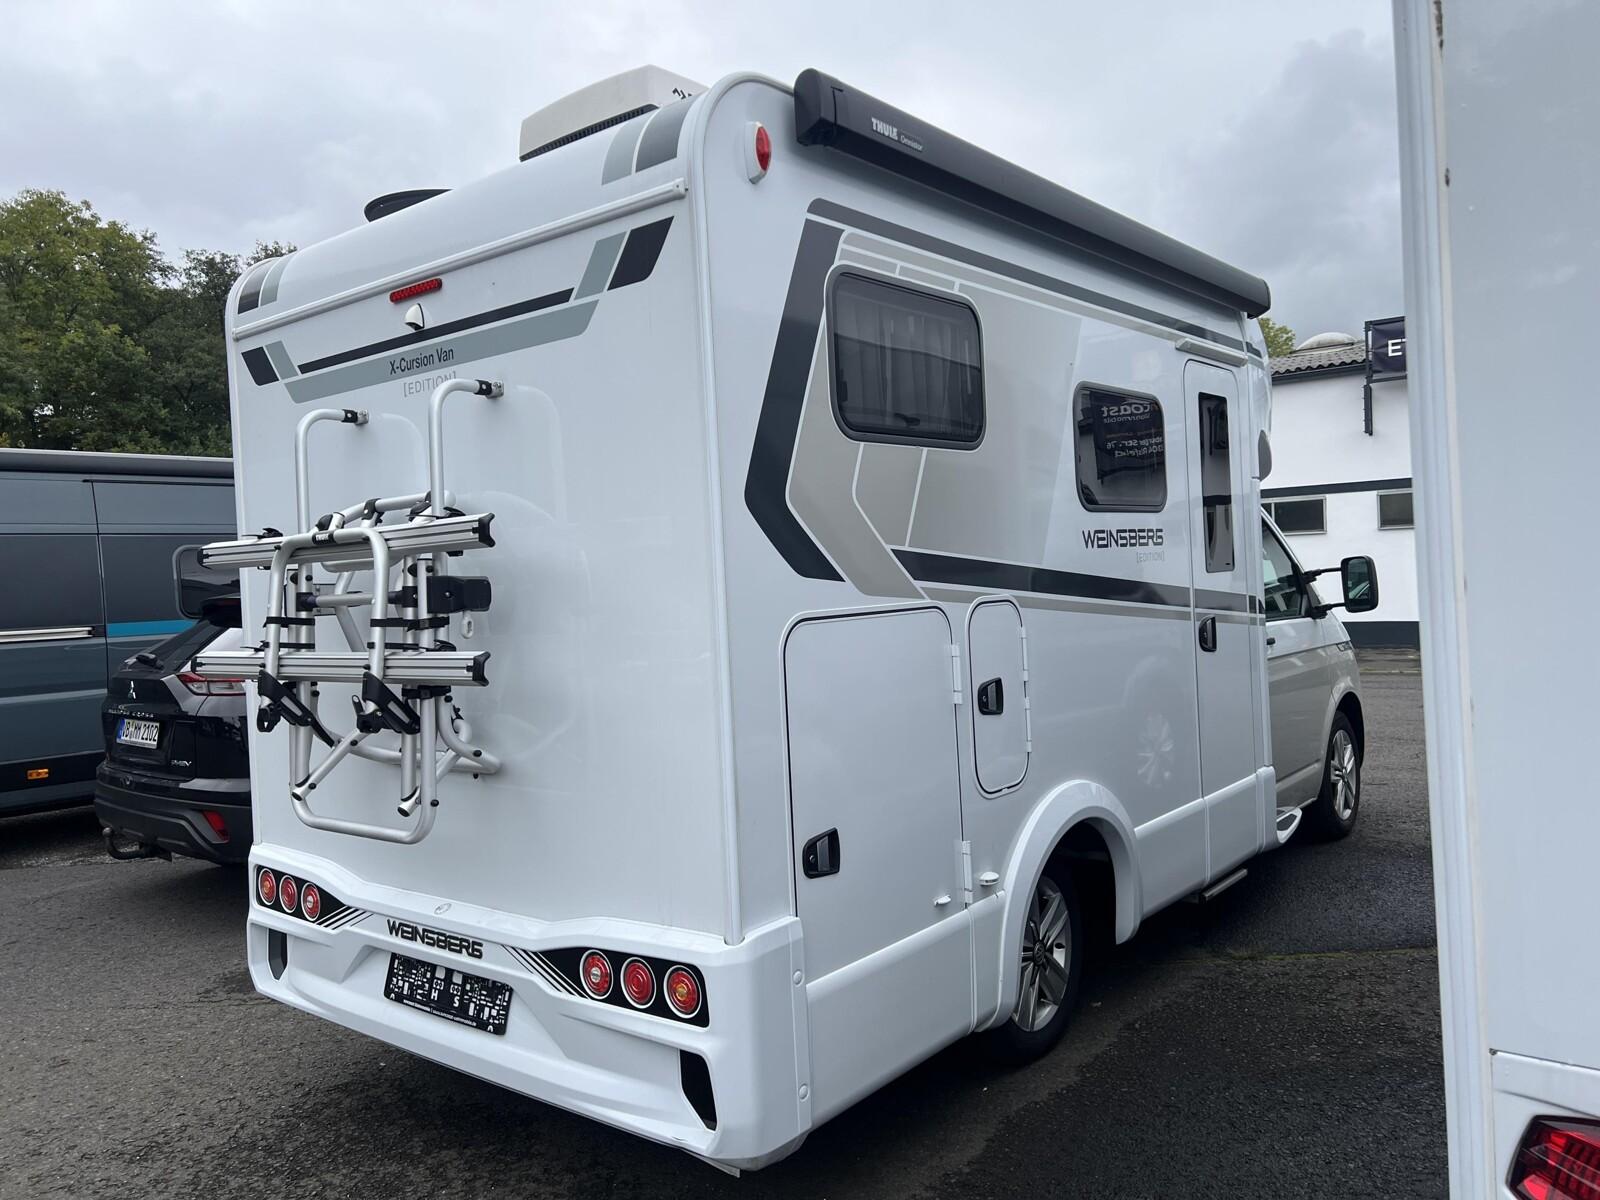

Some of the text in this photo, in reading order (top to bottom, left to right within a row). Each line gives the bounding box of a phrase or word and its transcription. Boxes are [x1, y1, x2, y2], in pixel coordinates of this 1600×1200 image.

[871, 117, 898, 140] THULE
[1388, 338, 1406, 356] E
[389, 348, 454, 375] X-Cursion Van
[1082, 529, 1164, 549] WEINSBERG
[141, 724, 159, 742] 2102
[387, 919, 484, 960] WEINSBERG
